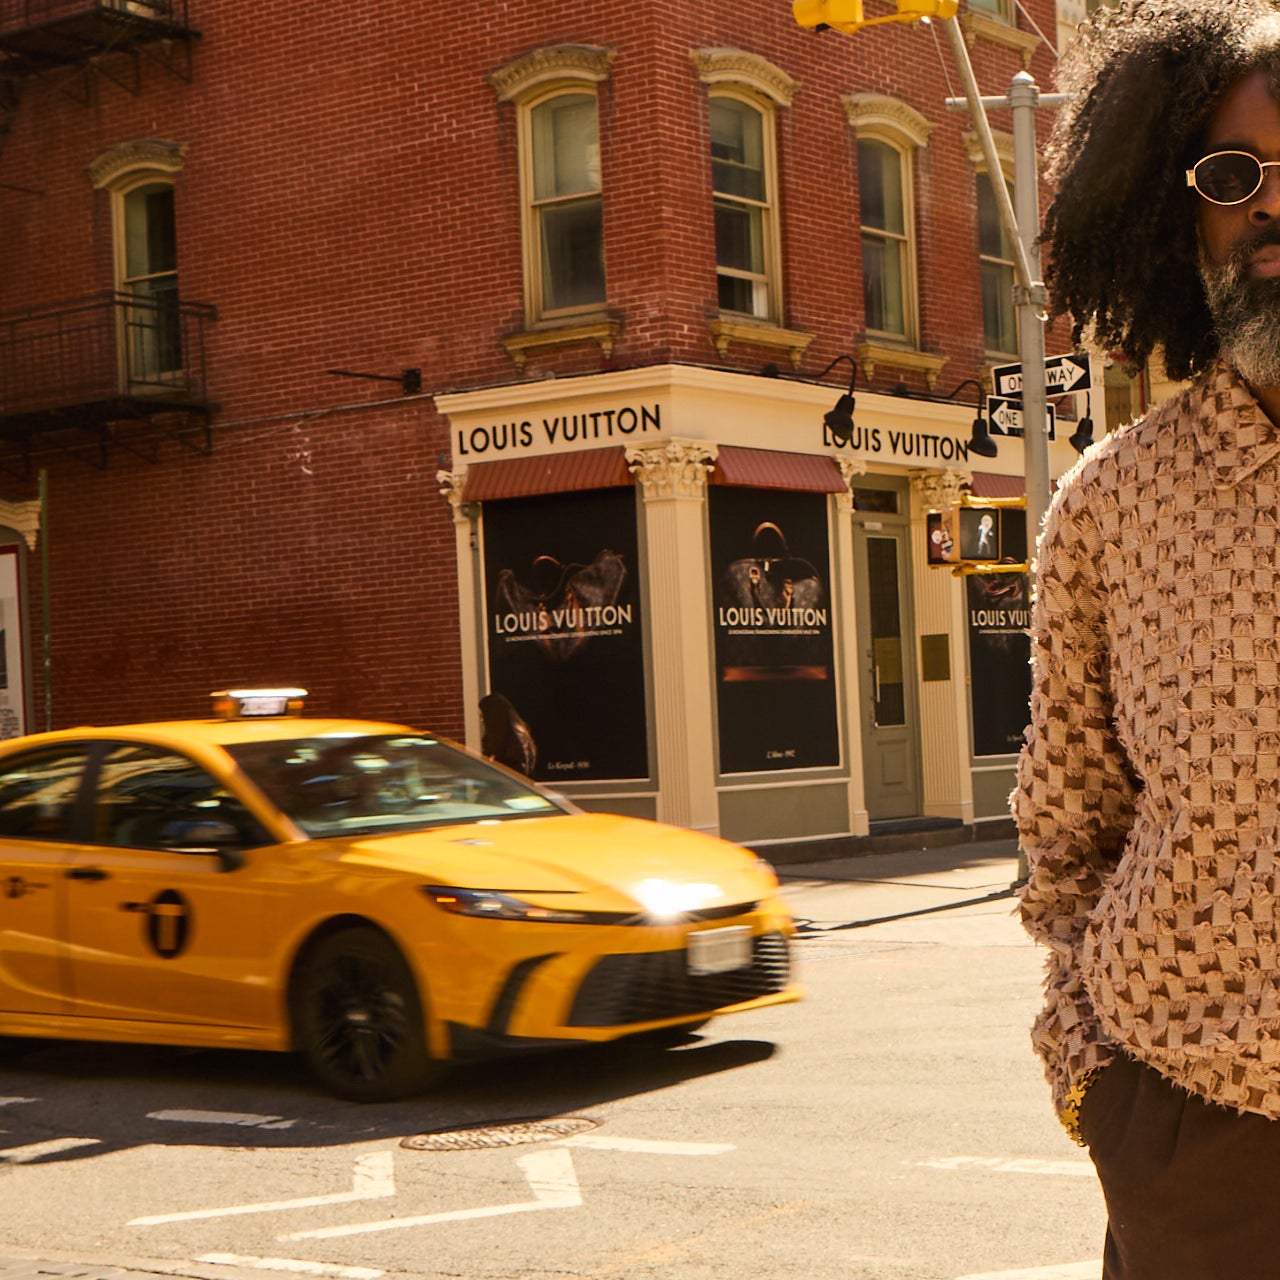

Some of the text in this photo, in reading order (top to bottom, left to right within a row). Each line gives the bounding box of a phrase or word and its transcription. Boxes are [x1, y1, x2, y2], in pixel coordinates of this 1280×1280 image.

[1047, 366, 1075, 384] WAY
[998, 410, 1018, 426] ONE
[458, 404, 661, 455] LOUIS VUITTON
[888, 430, 968, 462] VUITTON
[495, 604, 632, 634] LOUIS VUITTON
[719, 607, 827, 626] LOUIS VUITTON
[971, 609, 1006, 627] LOUIS
